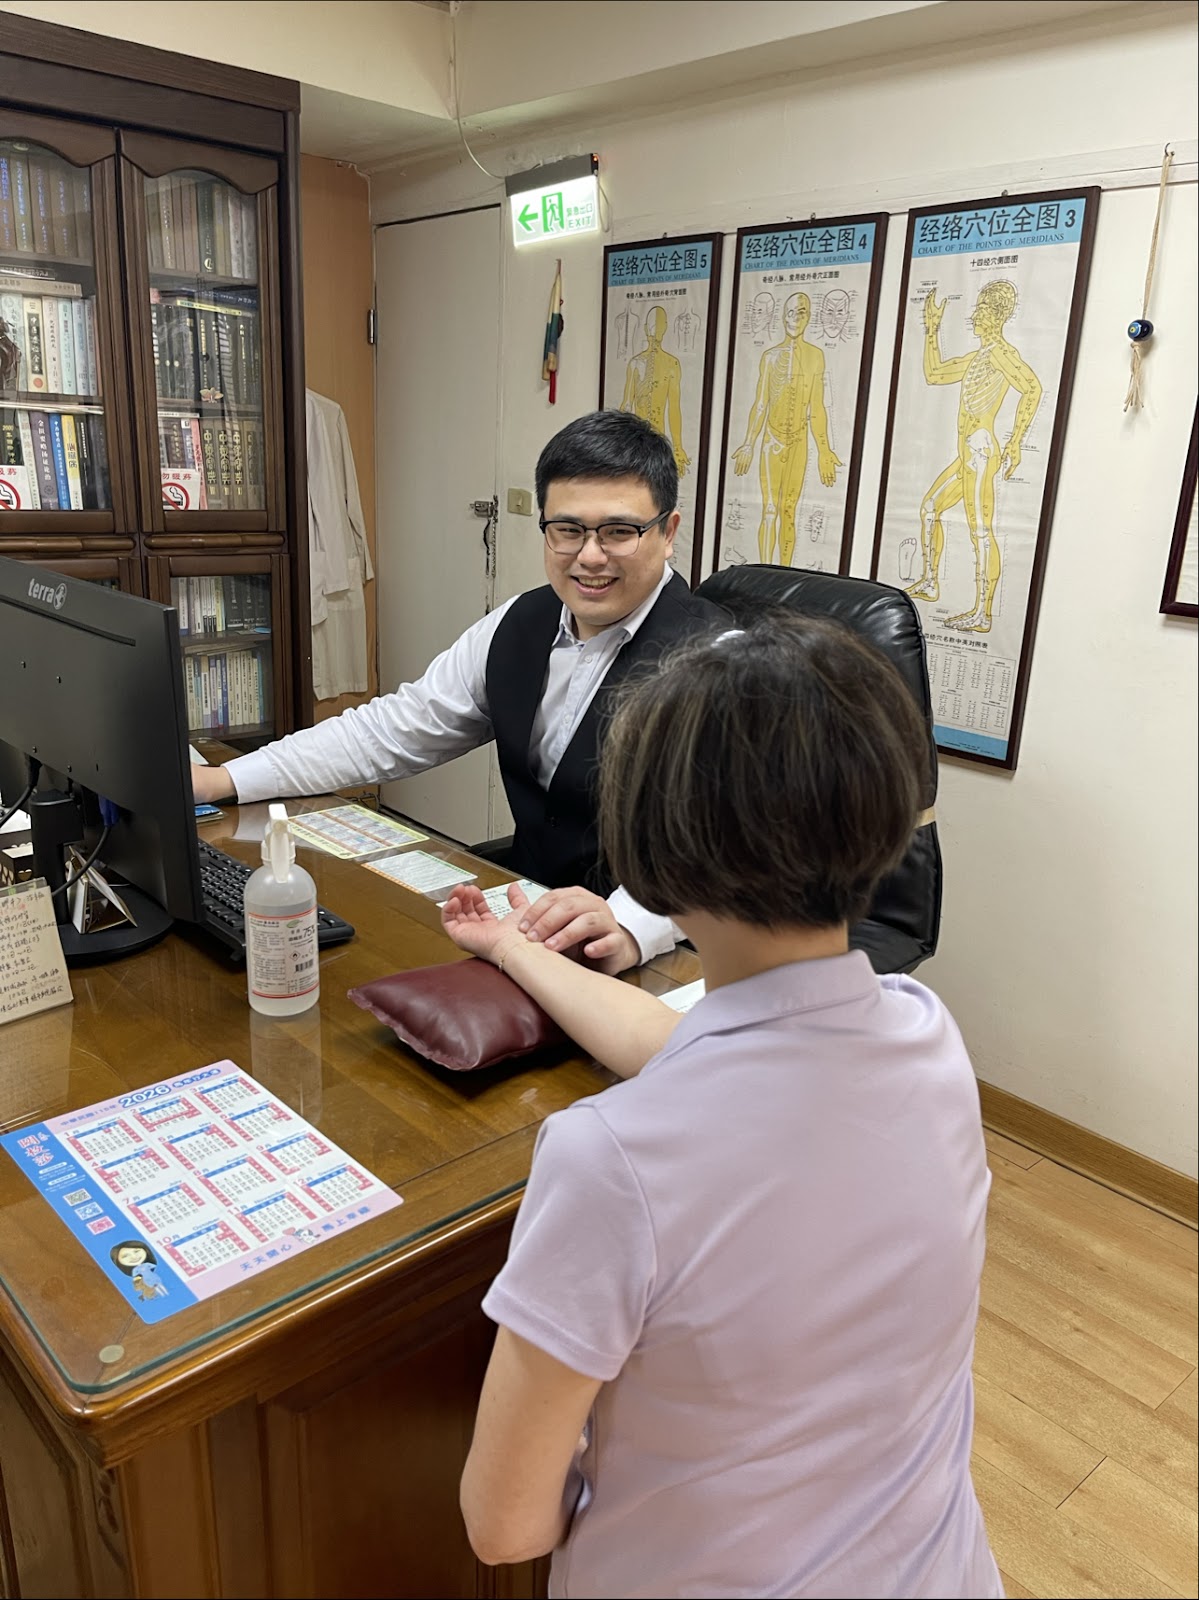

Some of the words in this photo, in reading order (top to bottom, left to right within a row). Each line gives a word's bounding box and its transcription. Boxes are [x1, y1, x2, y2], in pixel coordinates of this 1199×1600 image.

[568, 216, 592, 228] EXIT
[919, 203, 1061, 244] 经络穴位全图
[1065, 209, 1076, 228] 3
[745, 227, 856, 261] 经络穴位全图
[858, 233, 867, 249] 4
[917, 245, 942, 255] CHART
[944, 244, 956, 252] OF
[958, 242, 973, 251] THE
[975, 239, 1002, 250] POINTS
[1004, 238, 1014, 247] OF
[1018, 233, 1065, 246] MERIDIANS
[611, 248, 698, 278] 经络穴位全图
[700, 254, 708, 269] 5
[744, 260, 764, 270] CHART
[765, 259, 774, 268] OF
[776, 259, 788, 267] THE
[789, 257, 811, 267] POINTS
[812, 256, 822, 264] OF
[823, 253, 860, 264] MERIDIANS
[611, 278, 627, 287] CHART
[636, 276, 646, 284] THE
[647, 274, 664, 283] POINTS
[28, 578, 55, 603] terra
[119, 1084, 172, 1108] 2026
